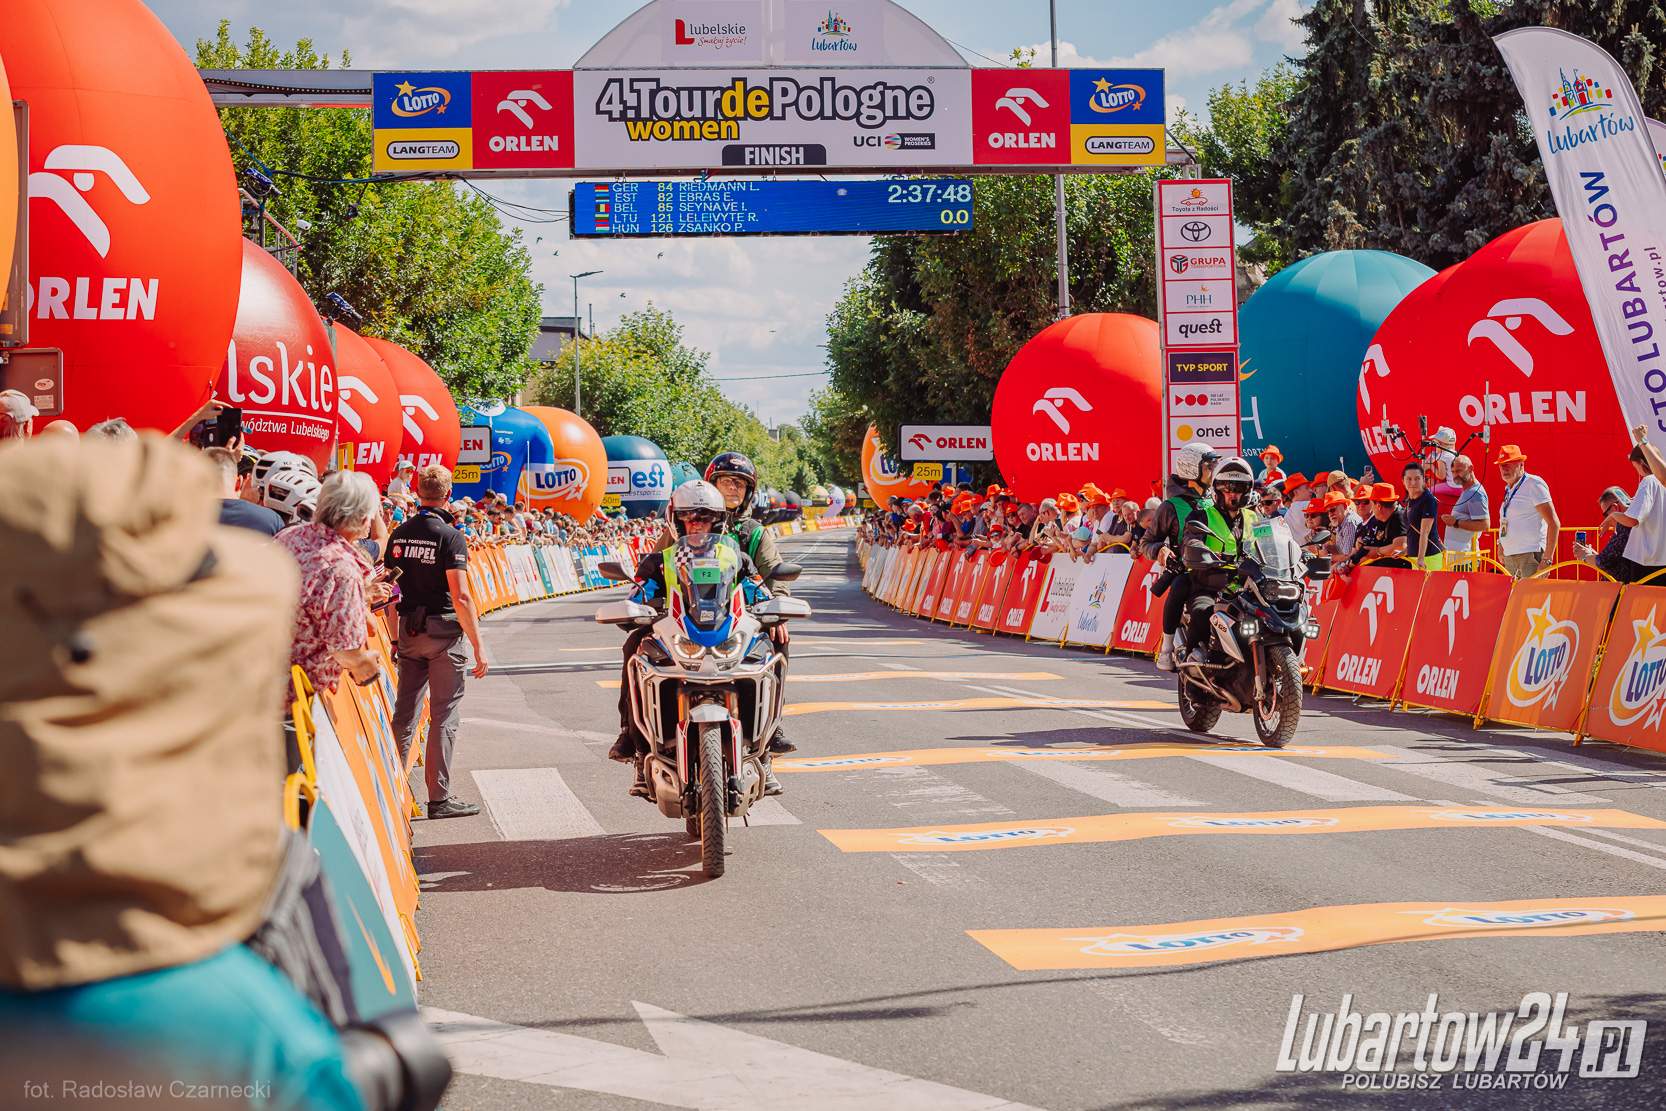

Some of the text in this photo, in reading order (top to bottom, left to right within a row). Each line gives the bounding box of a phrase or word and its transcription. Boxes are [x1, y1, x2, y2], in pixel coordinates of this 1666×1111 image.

[690, 23, 746, 35] lubelskie
[403, 92, 440, 112] LOTTO
[1100, 89, 1135, 108] LOTTO
[627, 118, 740, 141] women
[489, 135, 559, 152] ORLEN
[853, 136, 881, 147] UCI
[988, 132, 1056, 149] ORLEN
[1090, 141, 1150, 151] LANGTEAM
[393, 145, 455, 155] LANGTEAM
[744, 146, 804, 165] FINISH
[612, 183, 639, 192] GER
[657, 183, 673, 192] 84
[679, 182, 746, 191] RIEDMANN
[887, 184, 972, 203] 2:37:48
[615, 192, 734, 202] EST 82 EBRAS E.
[614, 203, 637, 213] BEL
[657, 203, 673, 212] 85
[679, 202, 738, 212] SEYNAVE
[614, 213, 637, 223] LTU
[650, 213, 673, 223] 121
[747, 212, 759, 222] R.
[940, 209, 969, 224] 0.0
[612, 223, 746, 233] HUN 126 ZSANKO P.
[1190, 257, 1226, 265] GRUPA
[1186, 294, 1212, 305] PHH
[1179, 318, 1222, 338] quest
[1176, 363, 1228, 372] TVP SPORT
[211, 339, 333, 412] lskie
[1459, 390, 1587, 427] ORLEN
[1196, 425, 1230, 438] onet
[935, 437, 987, 449] ORLEN
[1026, 442, 1099, 461] ORLEN
[454, 469, 479, 479] 25m
[535, 468, 576, 489] LOTTO
[916, 466, 941, 477] 25m
[404, 545, 436, 560] IMPEL
[1120, 619, 1150, 645] ORLEN
[1336, 653, 1382, 687] ORLEN
[1524, 641, 1567, 686] LOTTO
[1416, 663, 1460, 700] ORLEN
[1464, 911, 1588, 924] LOTTO
[1125, 931, 1254, 950] LOTTO
